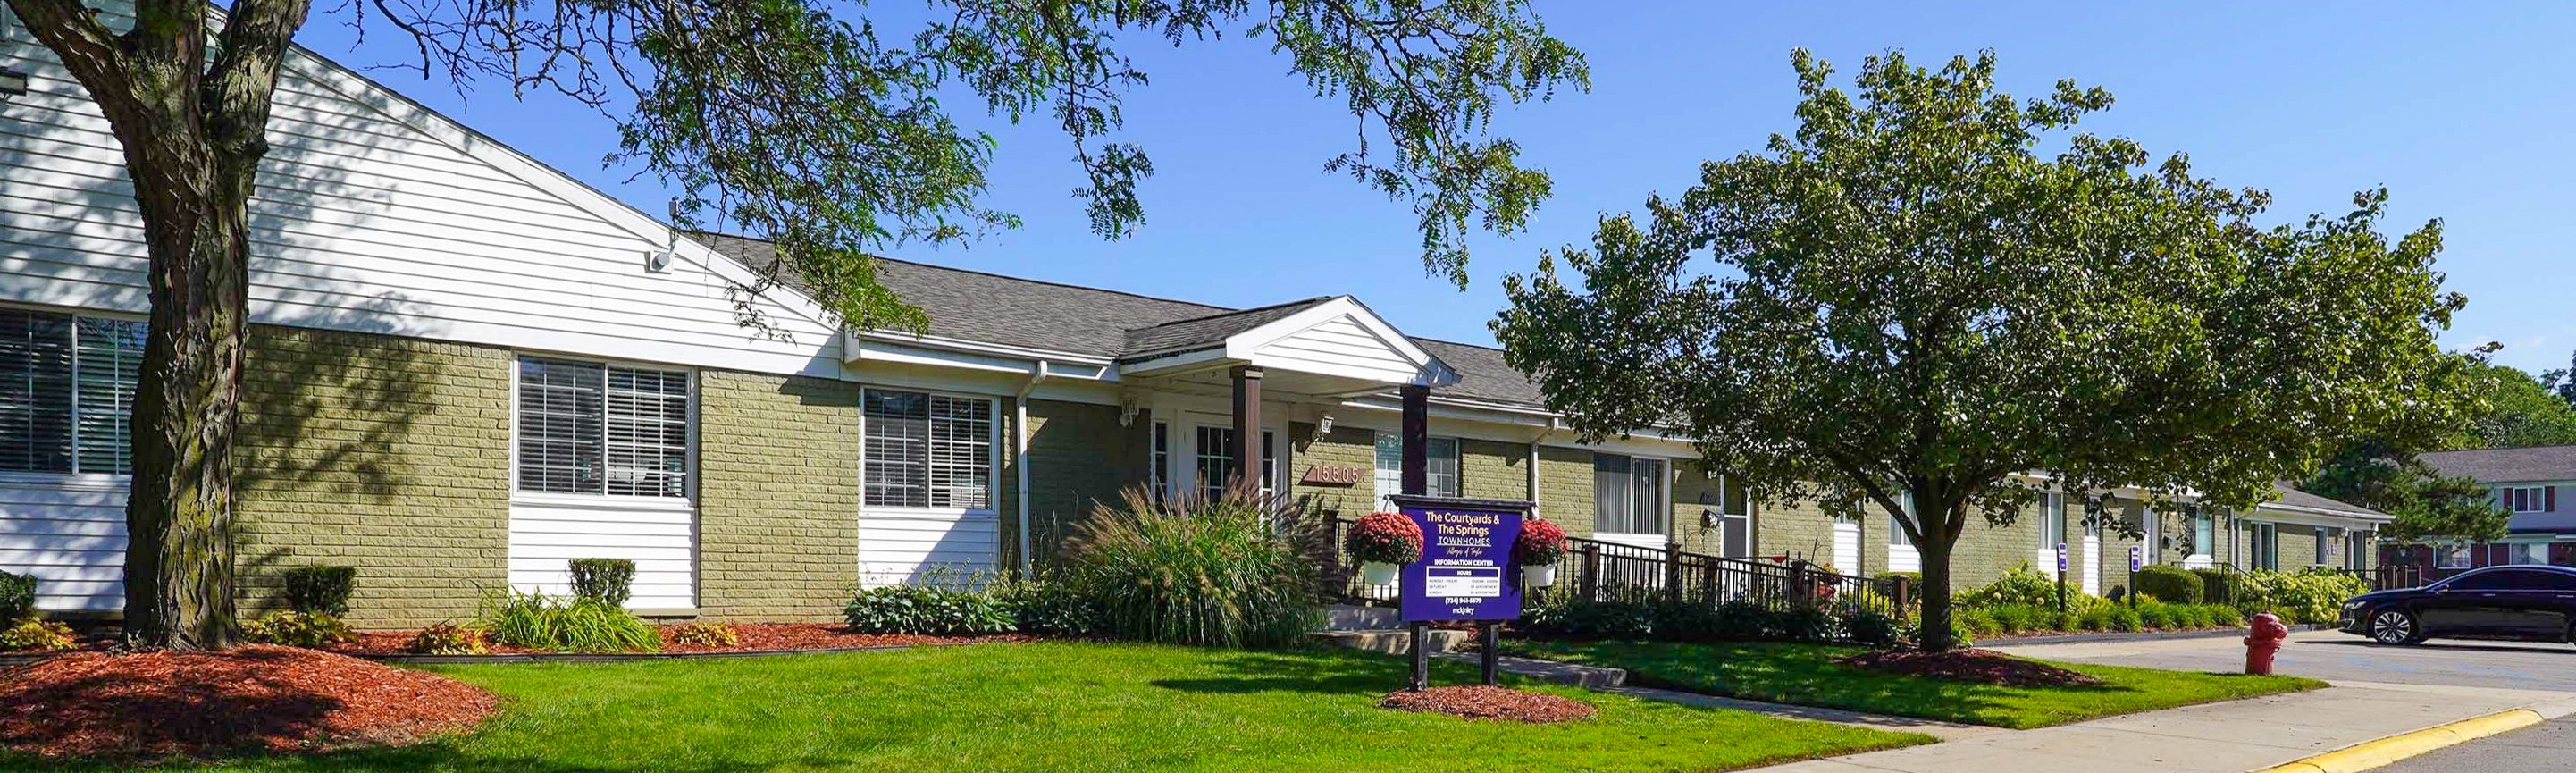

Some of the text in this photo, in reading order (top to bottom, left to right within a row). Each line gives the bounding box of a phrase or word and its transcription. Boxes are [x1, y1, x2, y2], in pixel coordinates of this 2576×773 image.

[1314, 465, 1358, 483] 15505
[1425, 511, 1500, 525] The Courtyards &
[1437, 524, 1489, 537] The Springs
[1438, 536, 1491, 546] TOWNHOMES
